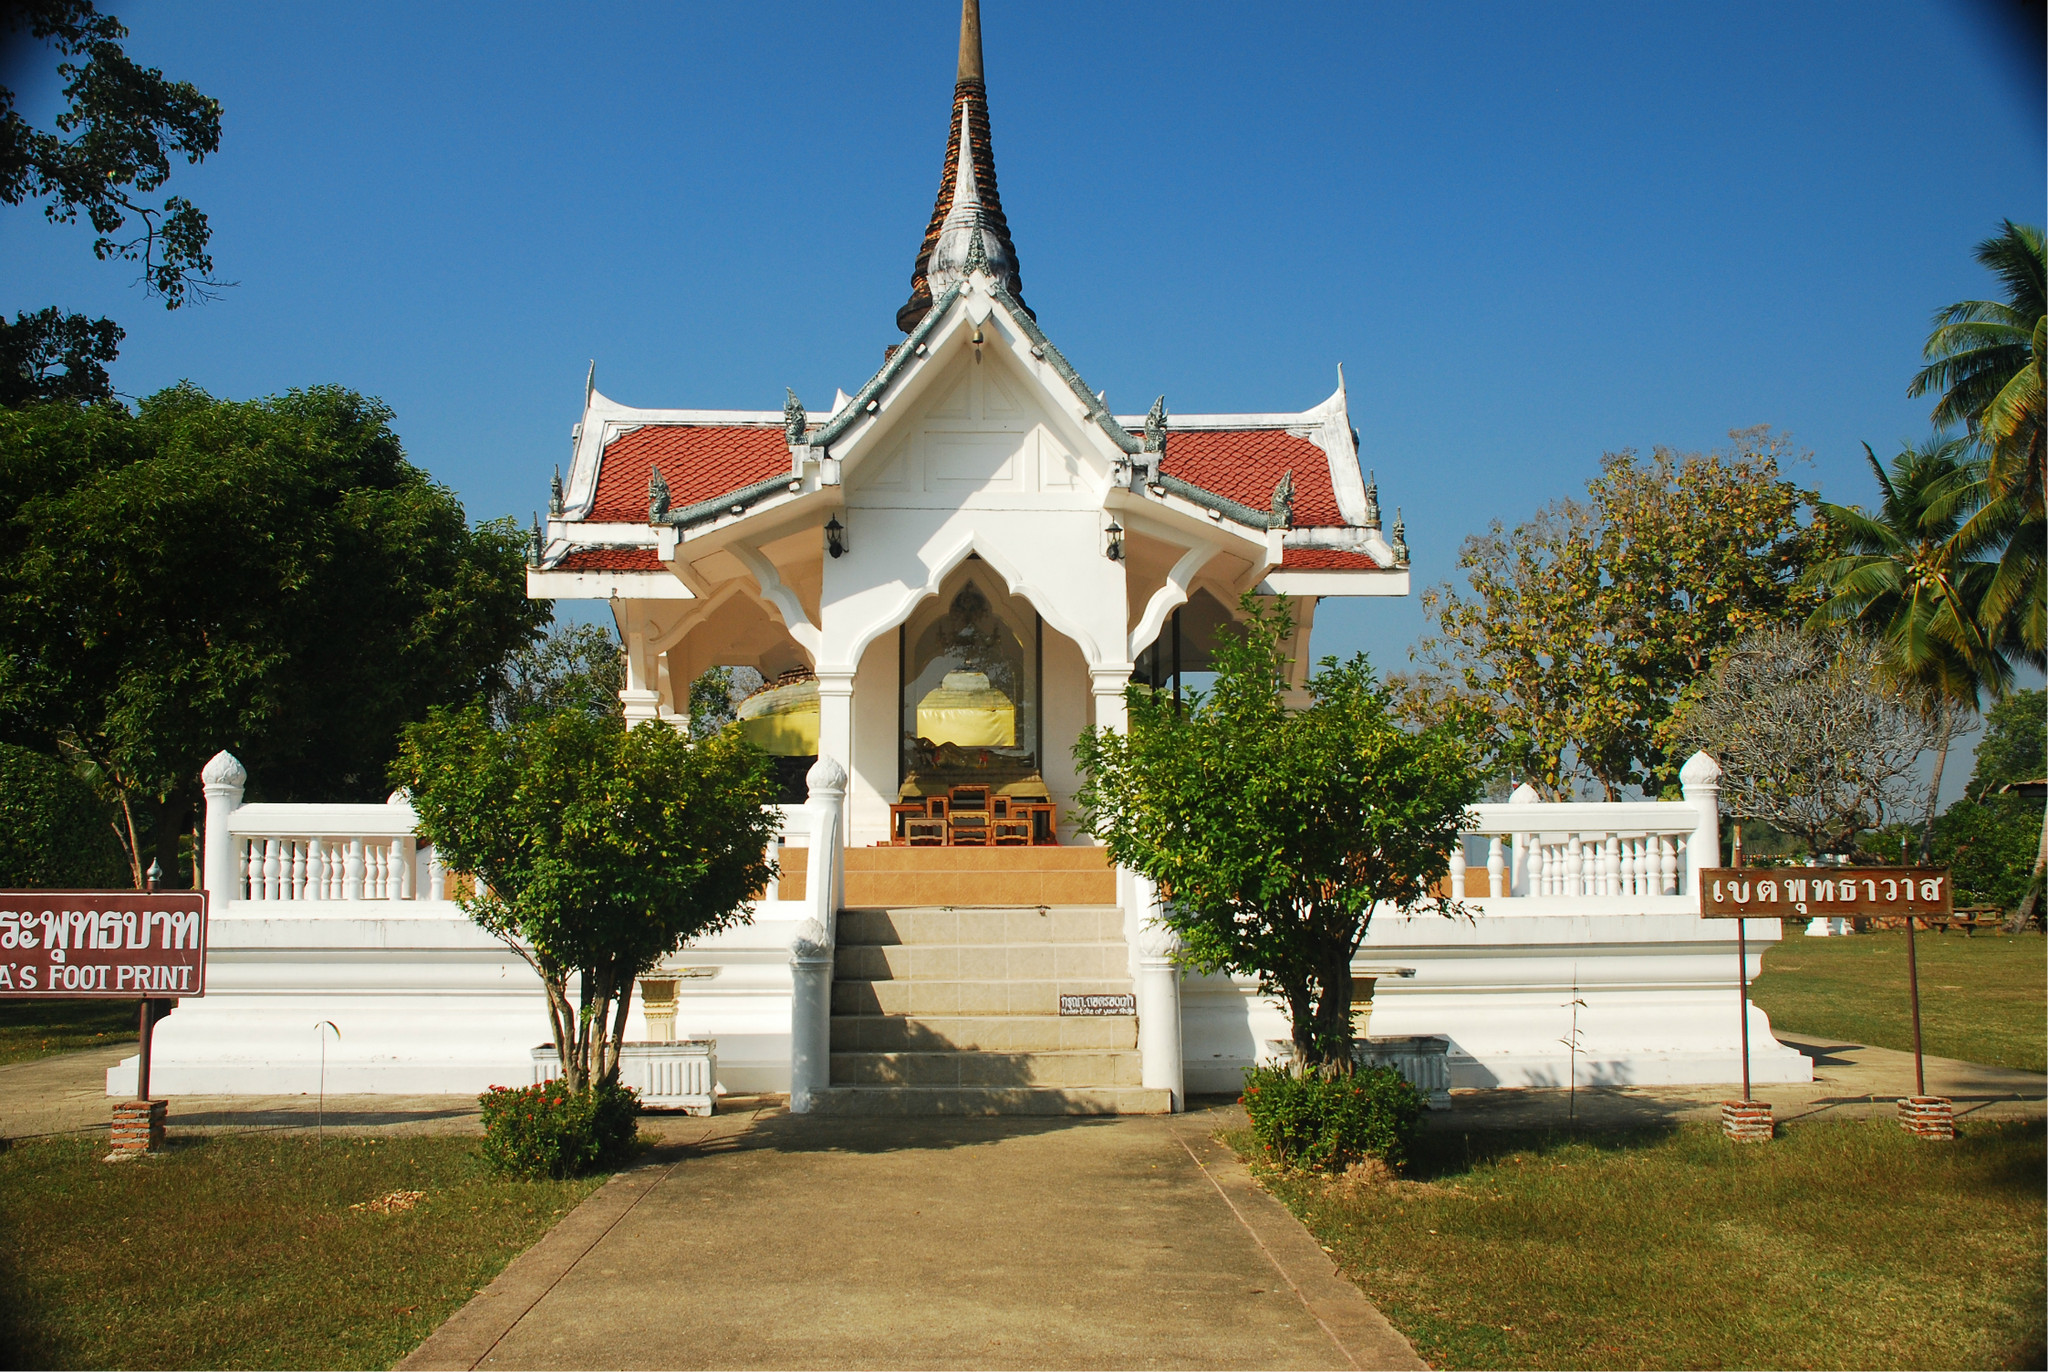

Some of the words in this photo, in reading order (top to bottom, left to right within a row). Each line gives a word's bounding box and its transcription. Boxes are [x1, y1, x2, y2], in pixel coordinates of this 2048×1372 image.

[1712, 876, 1944, 914] เขตพุทธาวาส
[48, 965, 111, 990] FOOT
[115, 965, 193, 990] PRINT
